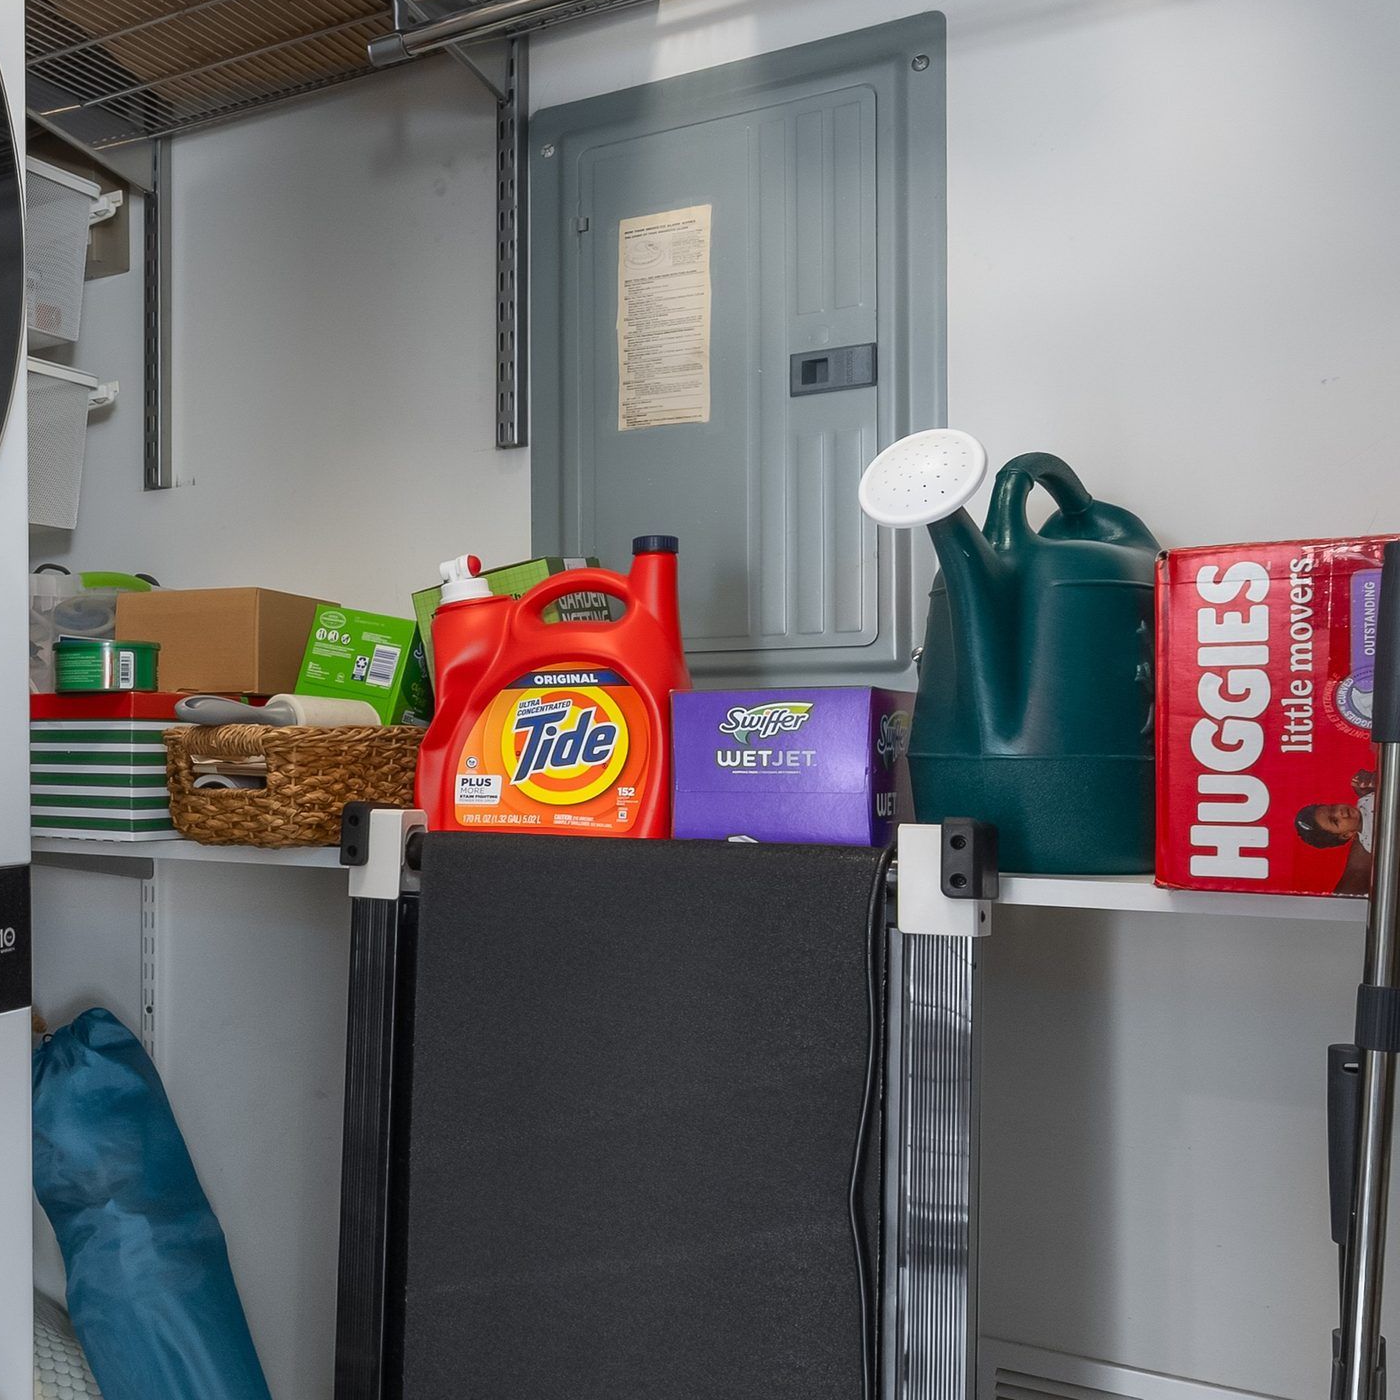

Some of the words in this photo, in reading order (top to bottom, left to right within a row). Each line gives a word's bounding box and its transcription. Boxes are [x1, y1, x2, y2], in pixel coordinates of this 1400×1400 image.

[1289, 557, 1313, 673] movers
[1364, 581, 1376, 656] OUTSTANDING
[533, 674, 599, 685] ORIGINAL
[516, 700, 572, 717] CONCENTRATED
[518, 699, 541, 709] ULTRA
[1280, 679, 1313, 754] little
[719, 706, 809, 739] Swiffer
[1189, 561, 1272, 880] HUGGIES
[512, 709, 618, 784] Tide
[461, 778, 492, 787] PLUS
[617, 787, 635, 796] 152
[0, 926, 16, 949] 10
